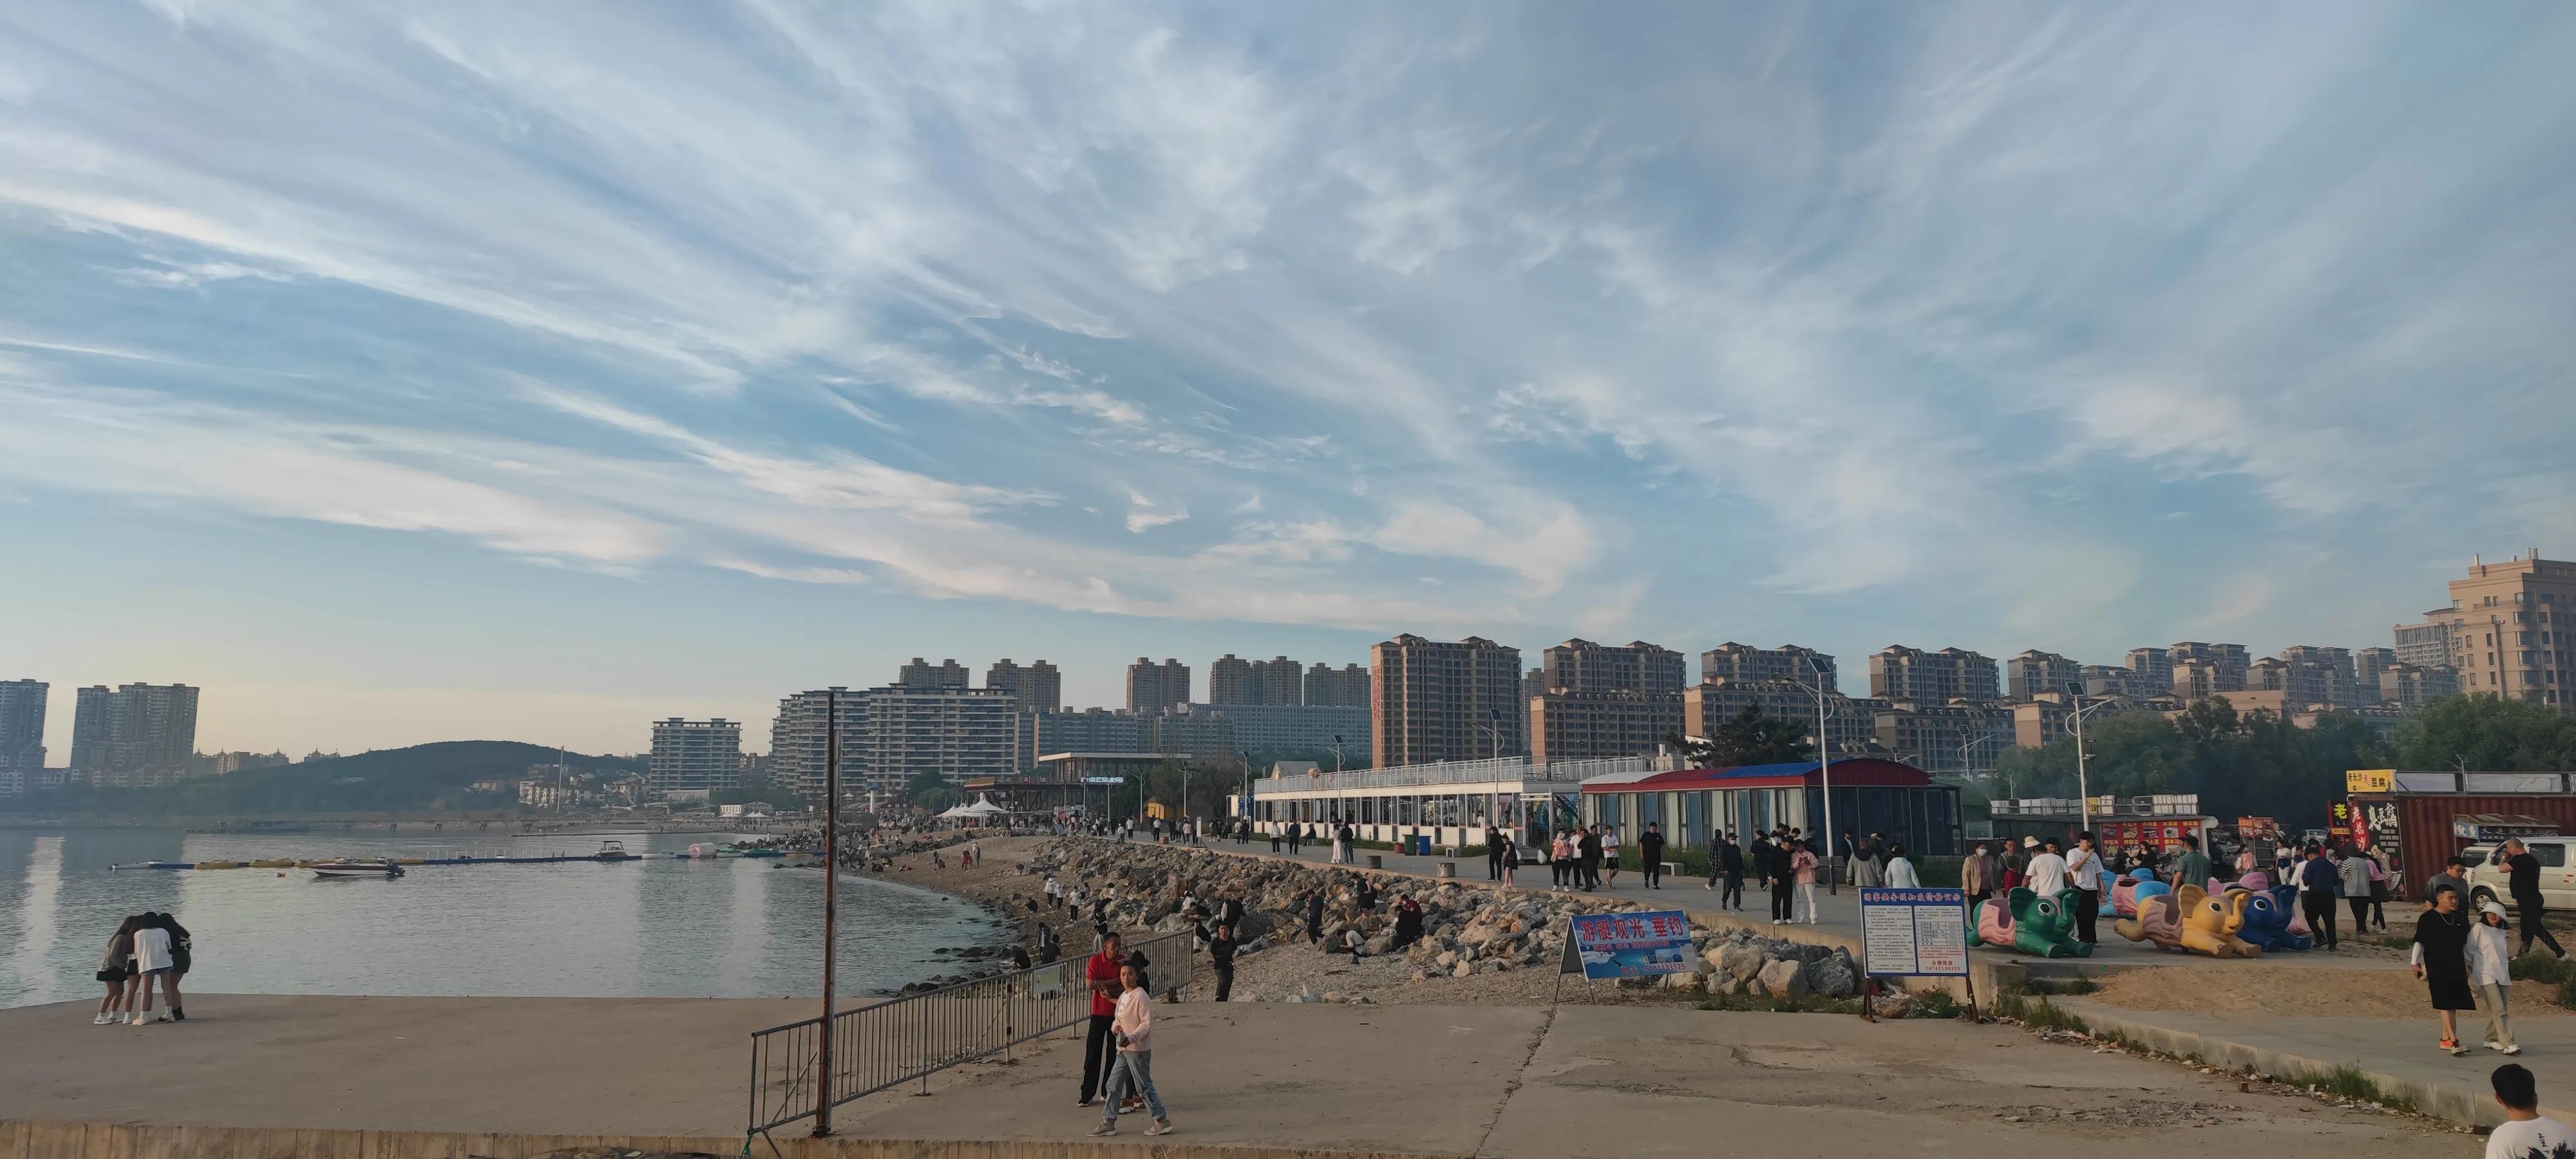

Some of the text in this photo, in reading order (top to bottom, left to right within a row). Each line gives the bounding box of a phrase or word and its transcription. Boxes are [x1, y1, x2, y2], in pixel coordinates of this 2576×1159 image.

[2367, 802, 2398, 831] 臭豆腐
[2457, 824, 2477, 837] 鱿鱼
[1579, 916, 1683, 942] 游艇观光 垂钓
